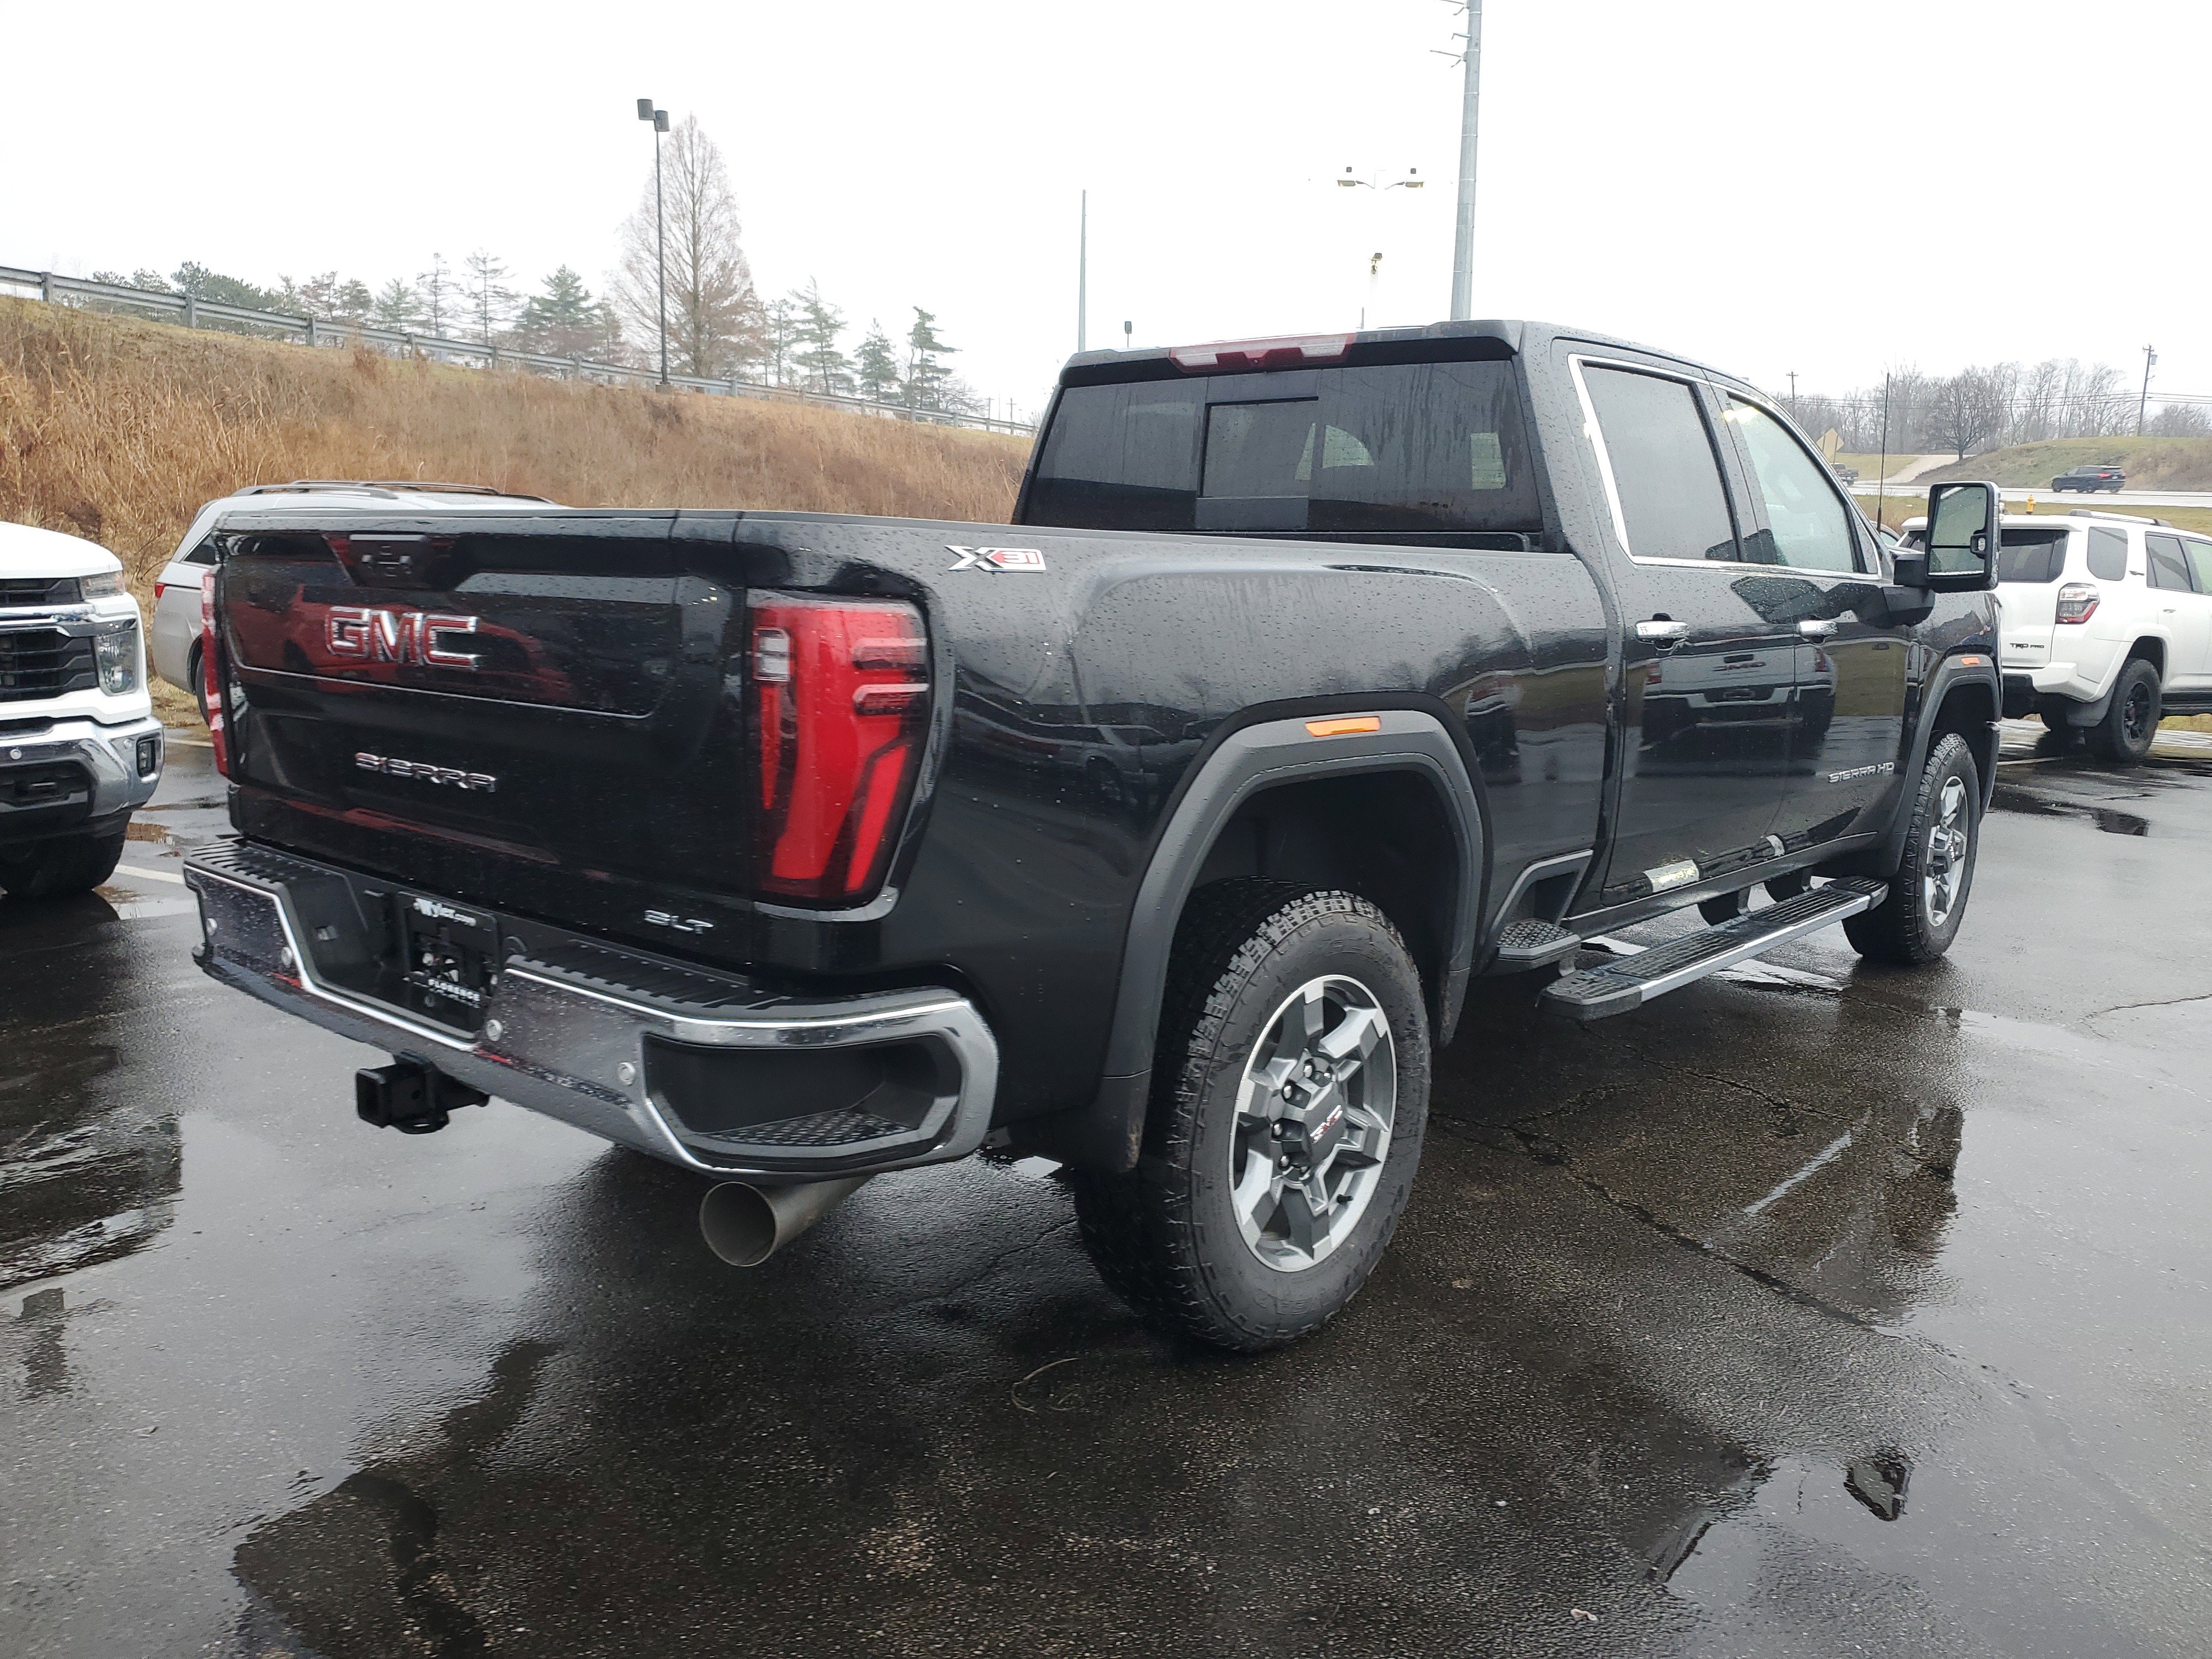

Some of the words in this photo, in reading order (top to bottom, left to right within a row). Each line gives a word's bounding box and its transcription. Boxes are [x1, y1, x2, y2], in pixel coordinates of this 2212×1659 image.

[325, 606, 481, 670] GMC
[355, 752, 497, 793] SIERRA
[1827, 765, 1877, 783] SIERRA
[1877, 761, 1895, 775] HD
[644, 910, 714, 934] SLT
[427, 979, 481, 1002] FLORENCE
